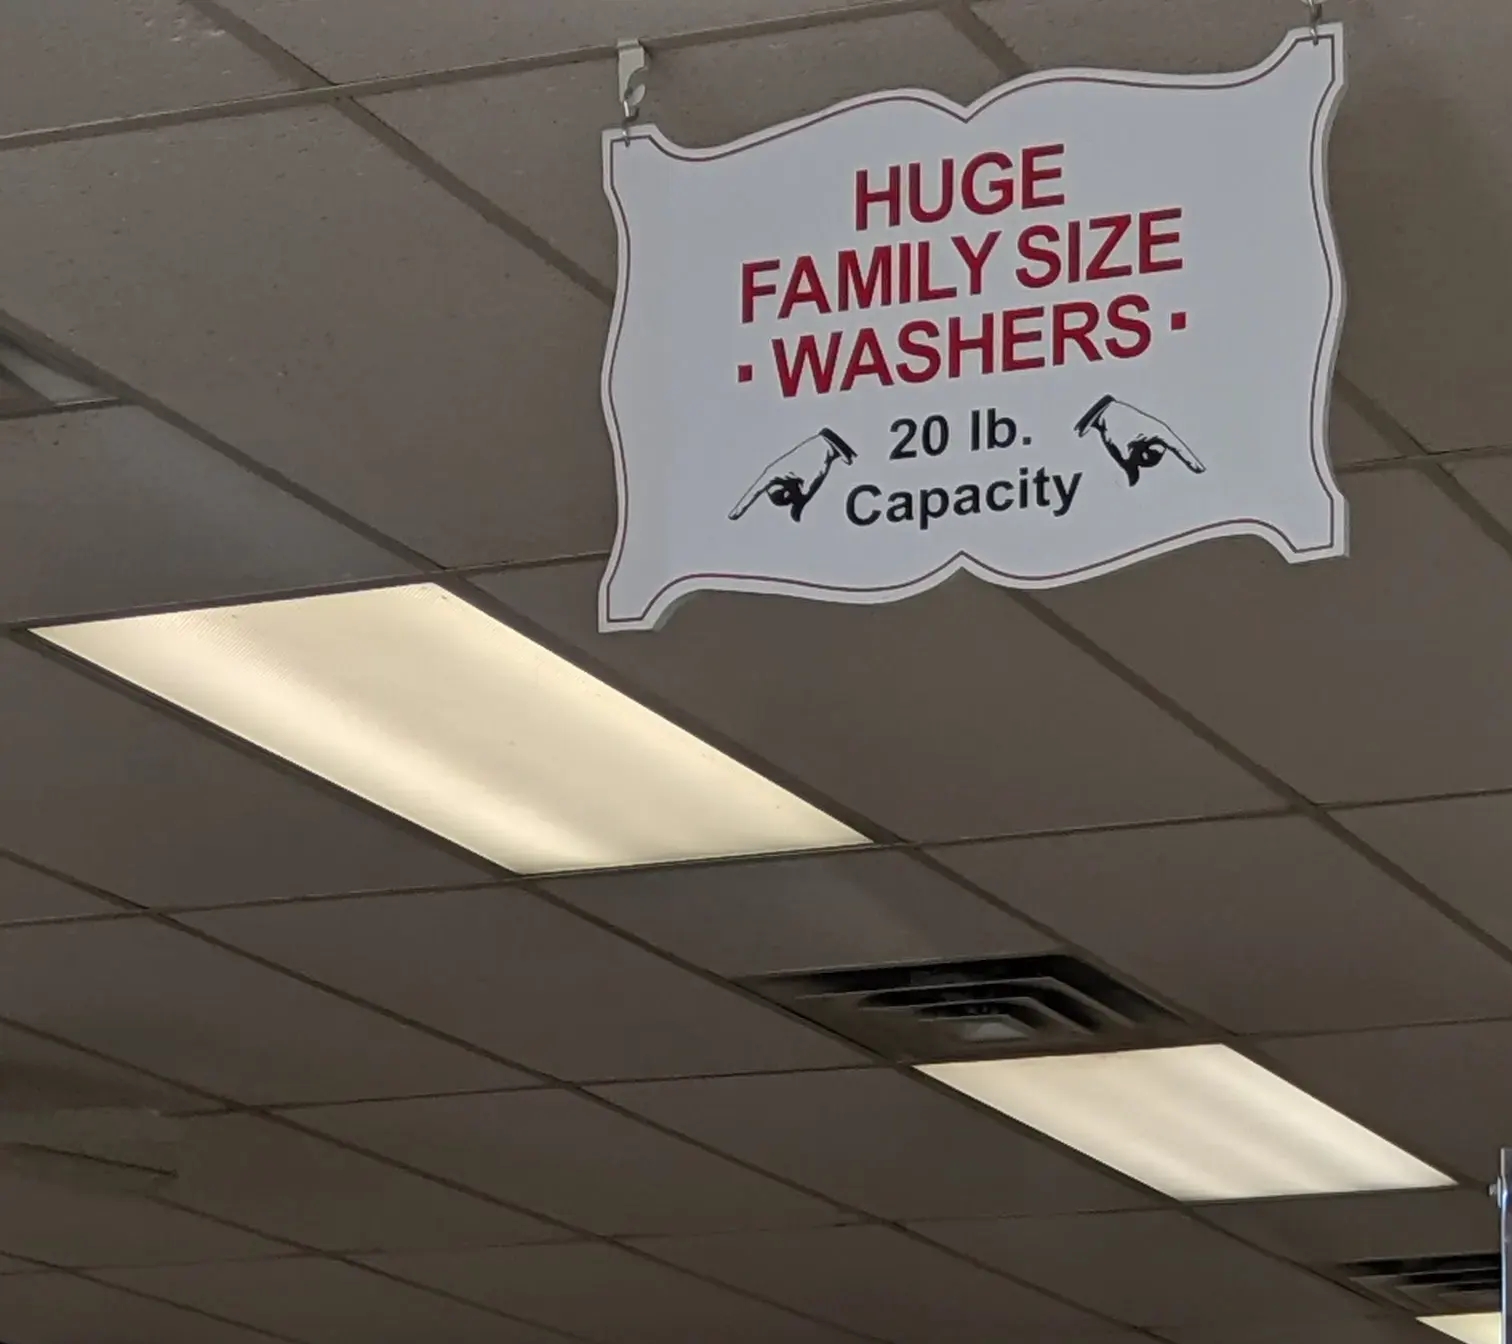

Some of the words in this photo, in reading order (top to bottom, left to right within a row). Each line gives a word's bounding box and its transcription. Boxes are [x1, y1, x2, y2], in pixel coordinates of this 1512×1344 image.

[853, 142, 1066, 232] HUGE
[738, 231, 1000, 324] FAMILY
[1014, 208, 1184, 290] SIZE
[770, 294, 1151, 398] WASHERS
[888, 416, 950, 460] 20
[969, 410, 1034, 453] lb.
[844, 467, 1083, 530] Capacity
